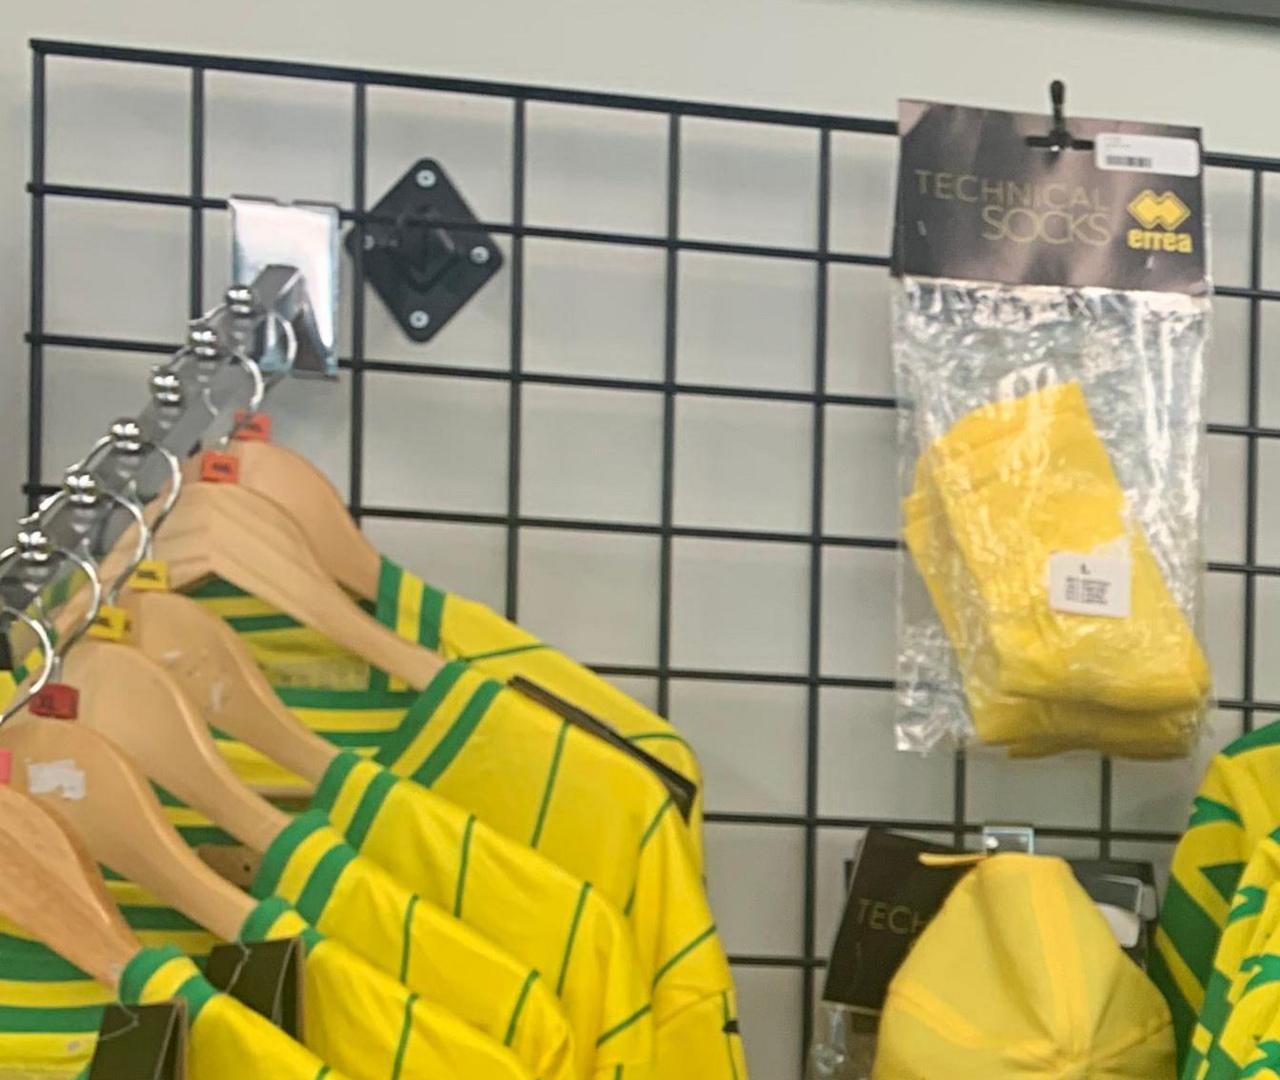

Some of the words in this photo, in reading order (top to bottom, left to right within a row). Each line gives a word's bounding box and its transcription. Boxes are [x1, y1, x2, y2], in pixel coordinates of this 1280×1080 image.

[914, 169, 1111, 209] TECHNICAL
[980, 204, 1112, 247] SOCKS
[1126, 228, 1194, 254] errea
